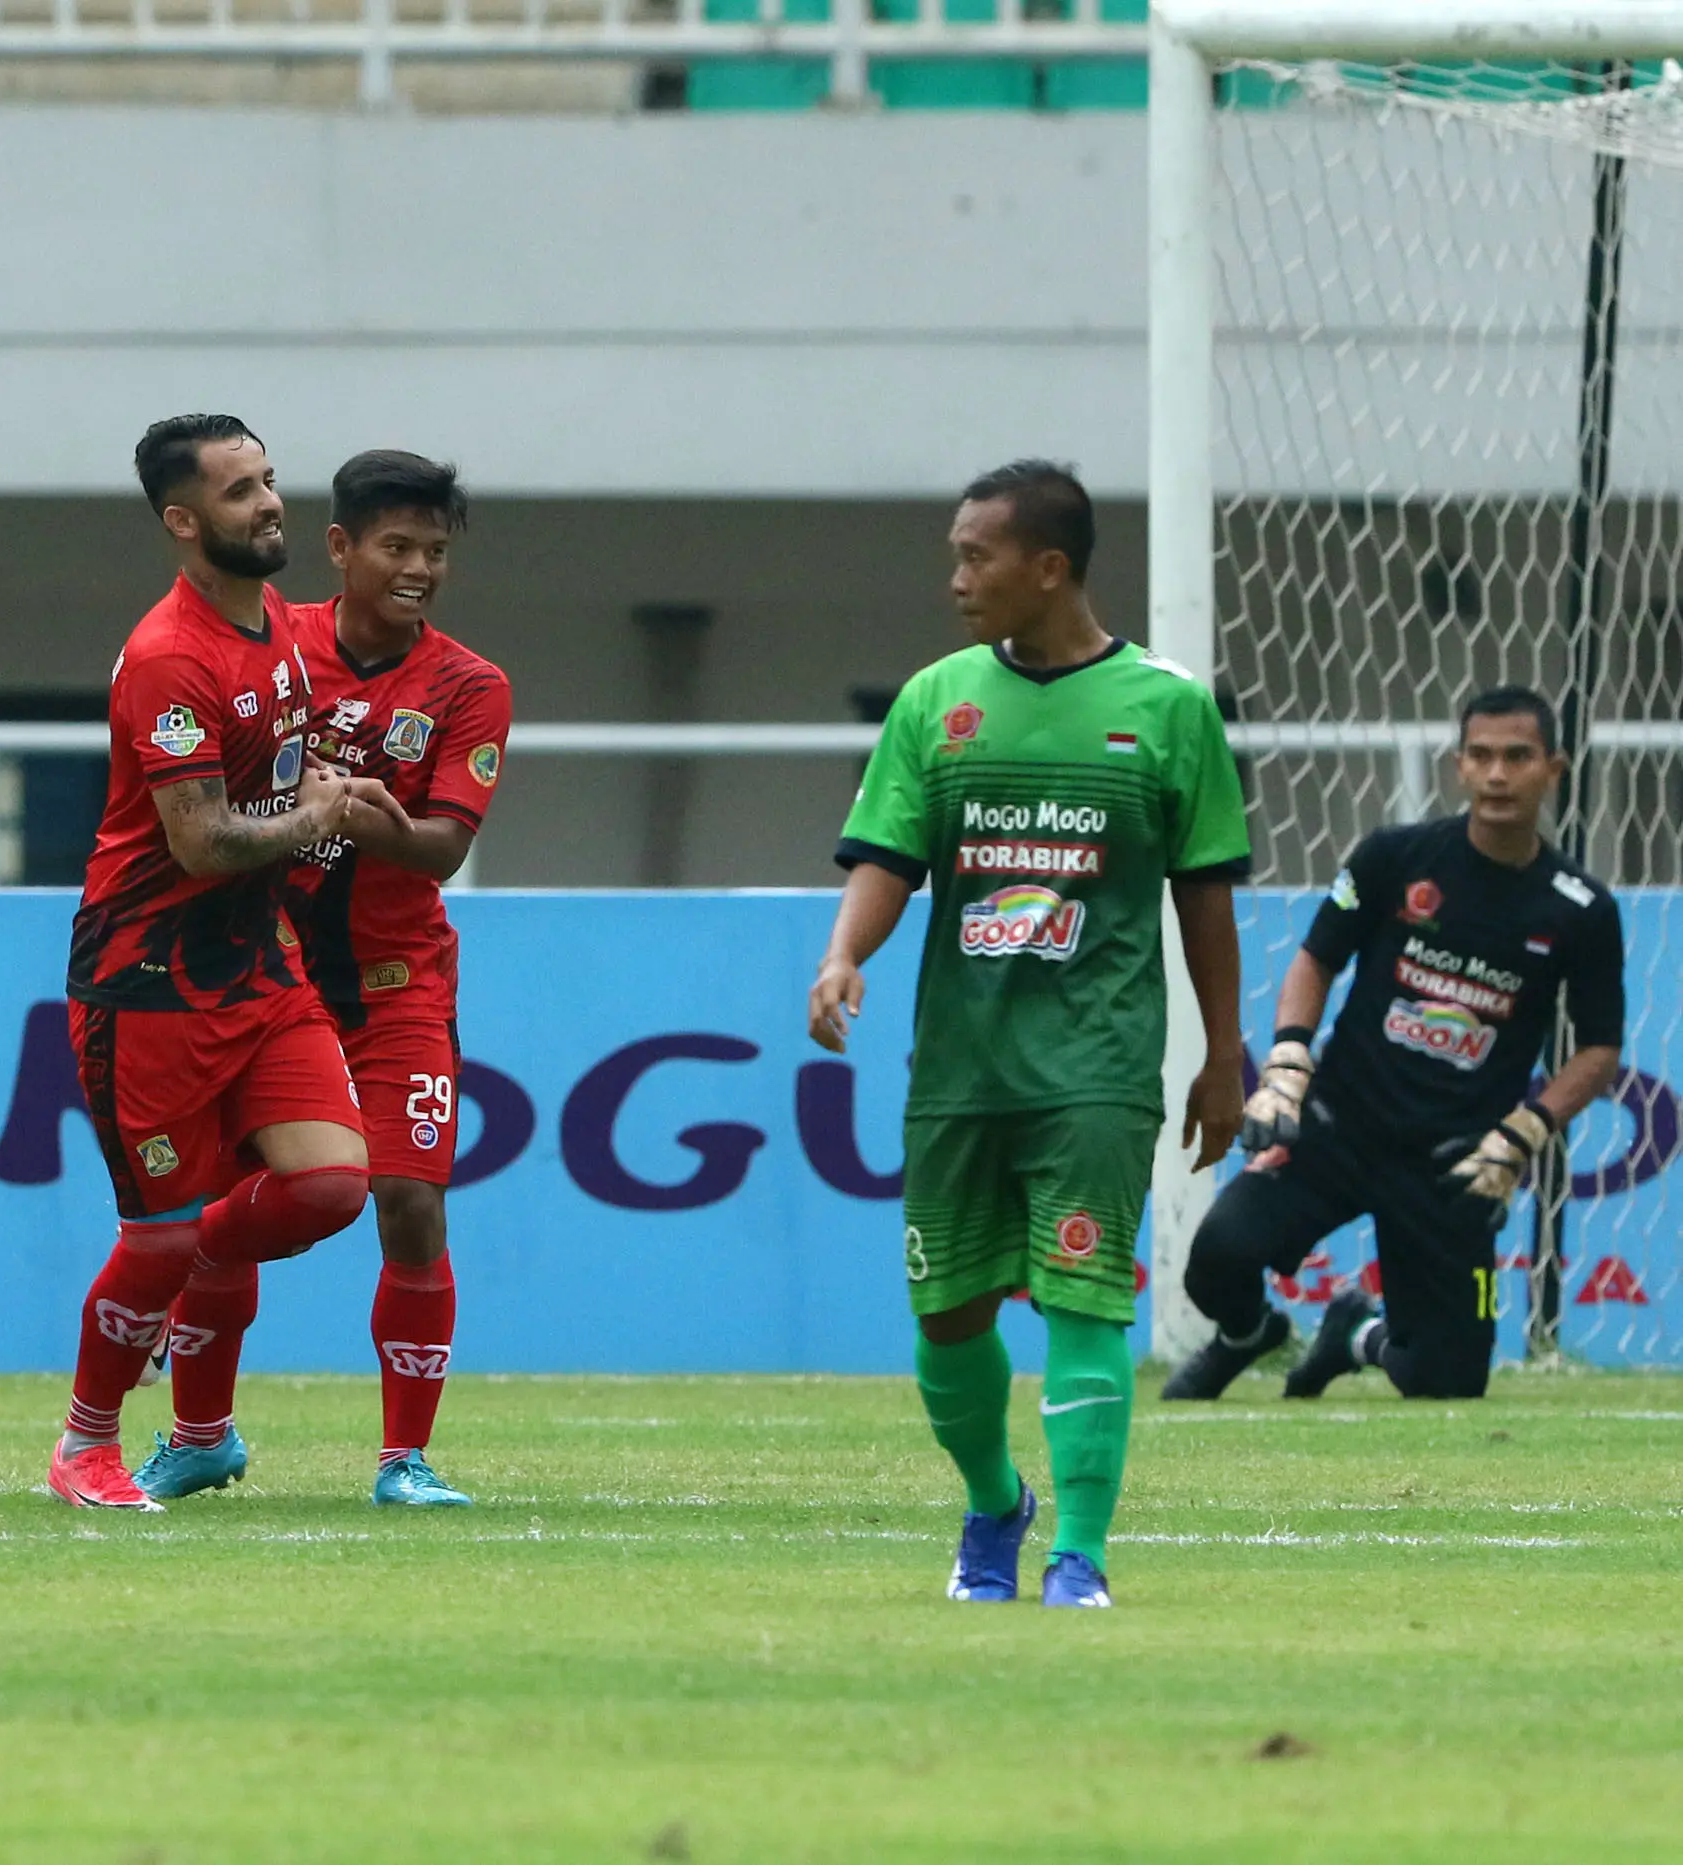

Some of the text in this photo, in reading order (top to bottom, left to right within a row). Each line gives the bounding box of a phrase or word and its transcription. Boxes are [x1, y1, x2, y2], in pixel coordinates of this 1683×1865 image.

[959, 844, 1100, 873] TORABIKA
[1398, 959, 1511, 1017] TORABIKA
[406, 1073, 452, 1123] 29
